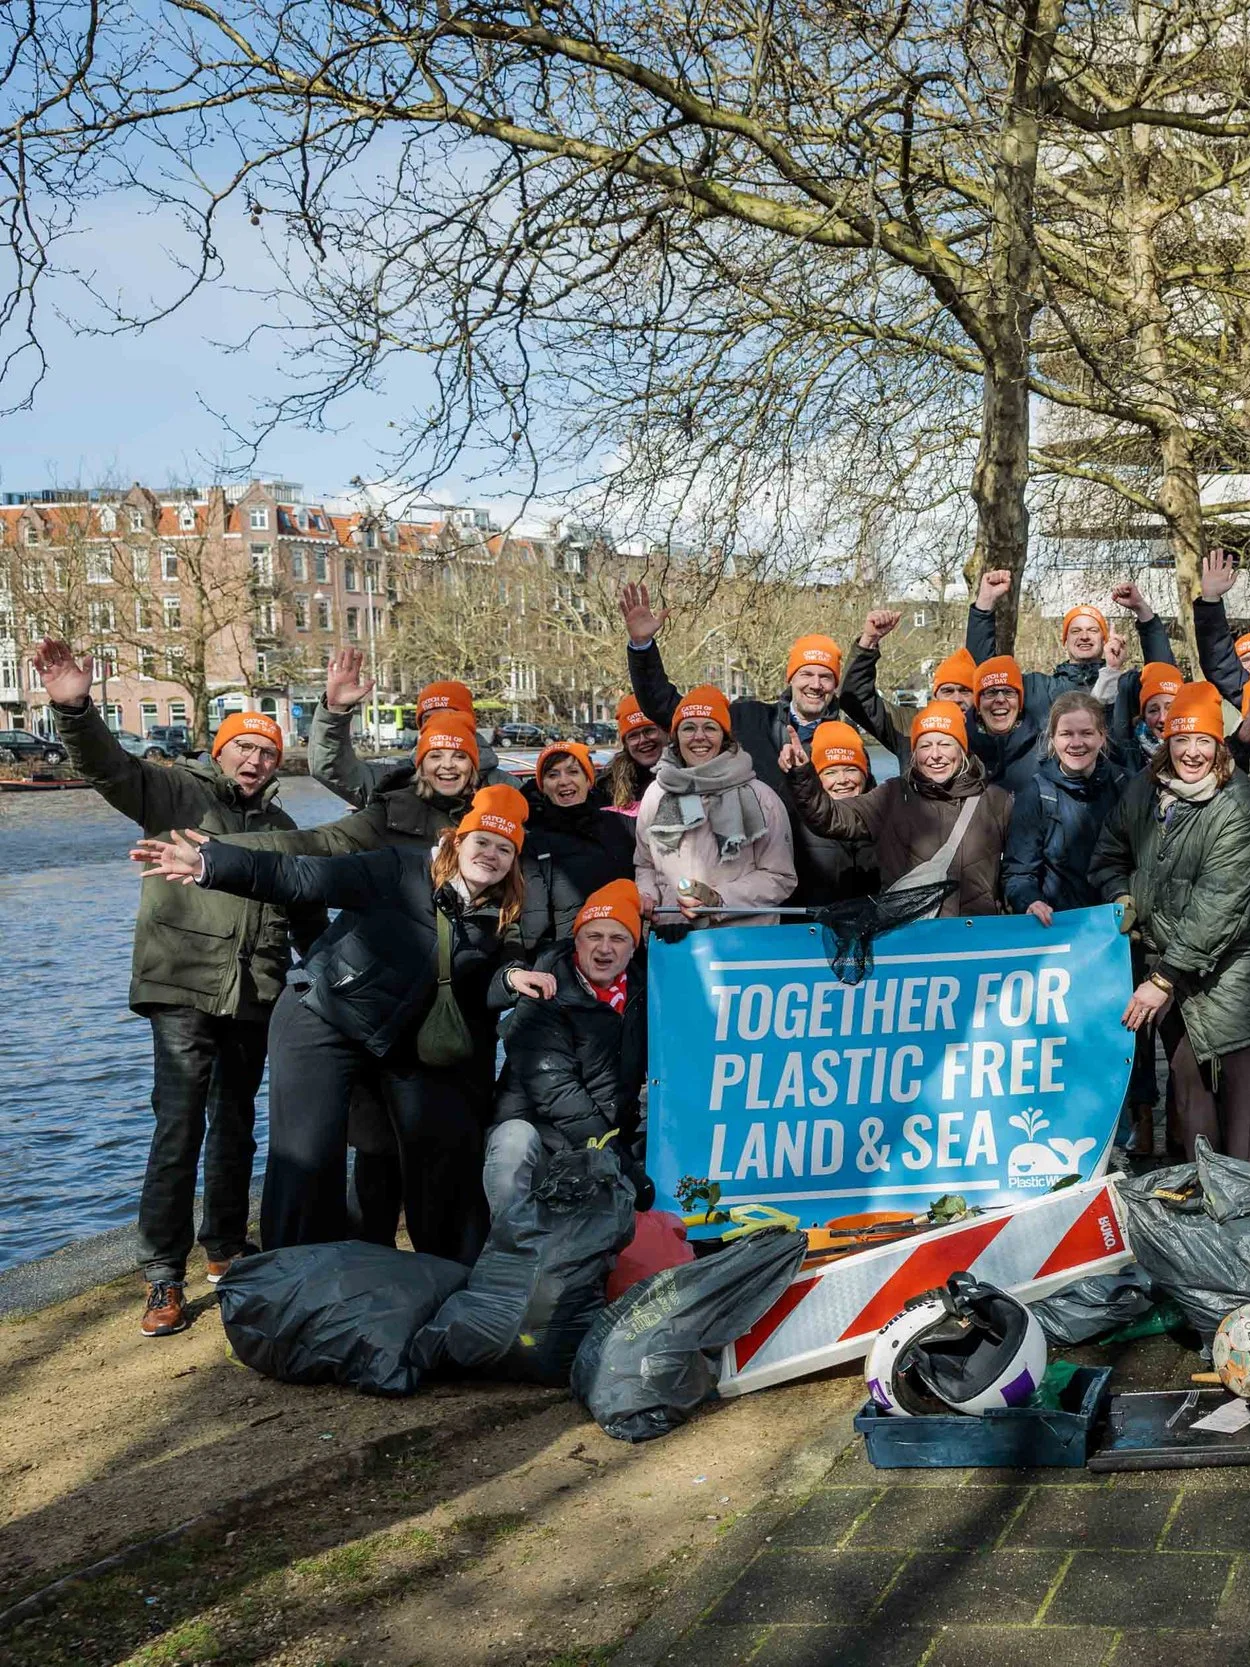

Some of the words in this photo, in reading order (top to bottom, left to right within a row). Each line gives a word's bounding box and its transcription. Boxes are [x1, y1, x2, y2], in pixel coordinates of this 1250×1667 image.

[981, 673, 999, 683] CATCH
[681, 704, 702, 713] CATCH
[682, 710, 695, 718] THE
[921, 716, 941, 725] CATCH
[430, 740, 446, 748] THE
[825, 747, 846, 755] CATCH
[481, 815, 507, 825] CATCH
[508, 821, 517, 829] OF
[481, 820, 498, 829] THE
[498, 824, 513, 835] DAY
[712, 976, 961, 1041] TOGETHER
[972, 968, 1071, 1029] FOR
[710, 1044, 924, 1111] PLASTIC
[941, 1036, 1067, 1100] FREE
[710, 1118, 845, 1181] LAND
[855, 1116, 891, 1173] &
[900, 1109, 999, 1171] SEA
